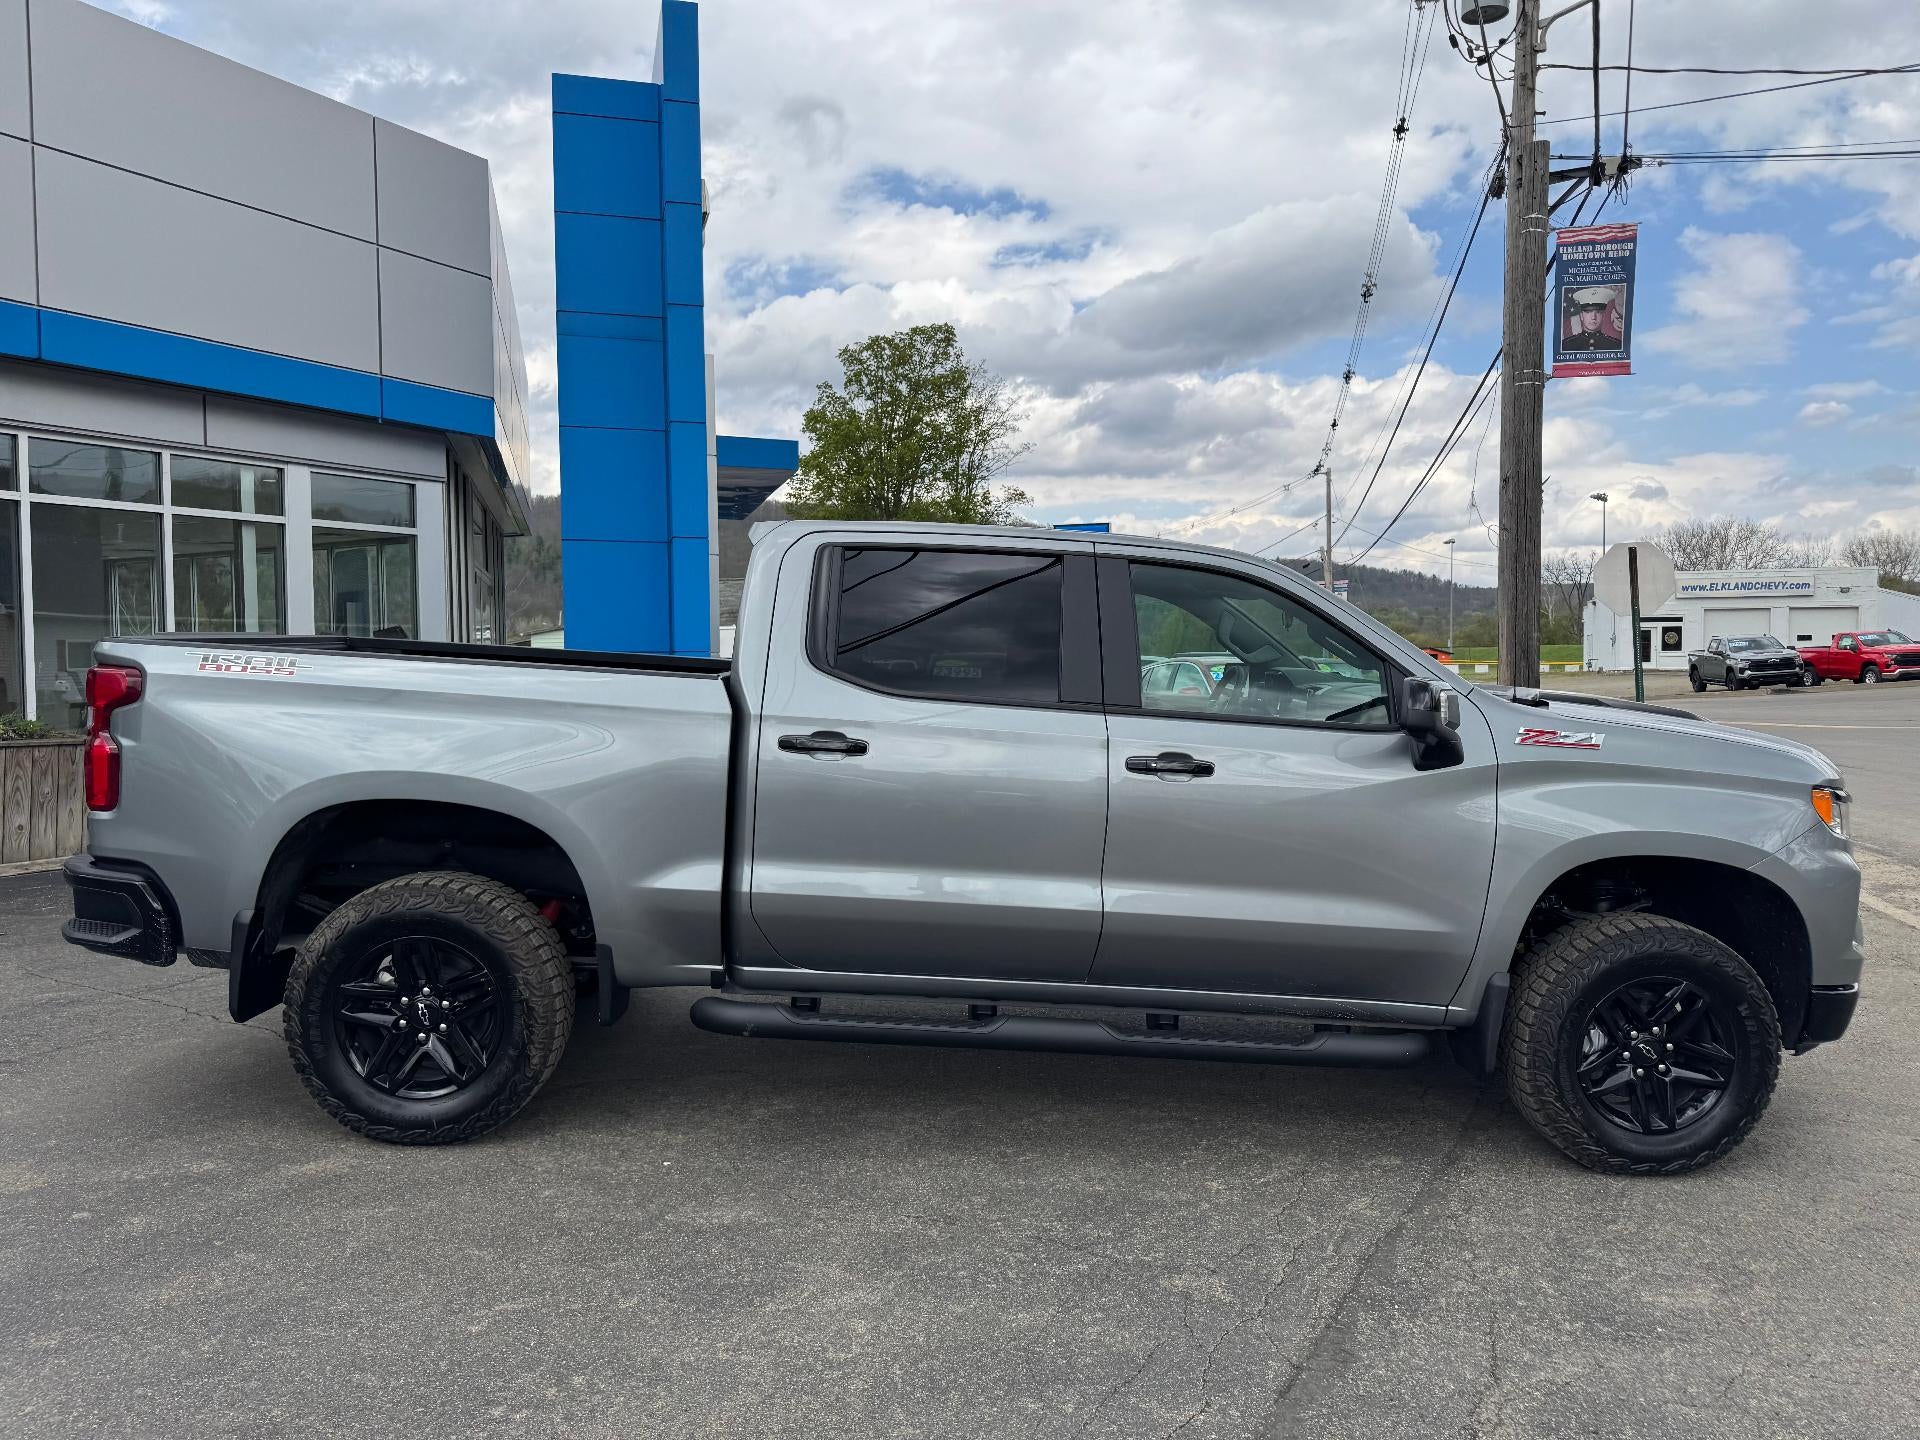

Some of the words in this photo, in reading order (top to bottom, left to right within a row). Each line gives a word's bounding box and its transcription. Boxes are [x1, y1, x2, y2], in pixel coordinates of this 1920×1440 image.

[1559, 245, 1593, 254] ELKLAND
[1595, 242, 1634, 251] BOROUGH
[1562, 251, 1606, 260] HOMETOWN
[1568, 266, 1599, 274] MICHAEL
[1576, 274, 1603, 282] MARINE
[1604, 273, 1627, 281] CORPS
[1681, 581, 1811, 592] www.ELKLANDCHEVY.com
[185, 651, 313, 668] TRAIL
[197, 663, 297, 676] BOSS
[1515, 727, 1606, 750] Z71
